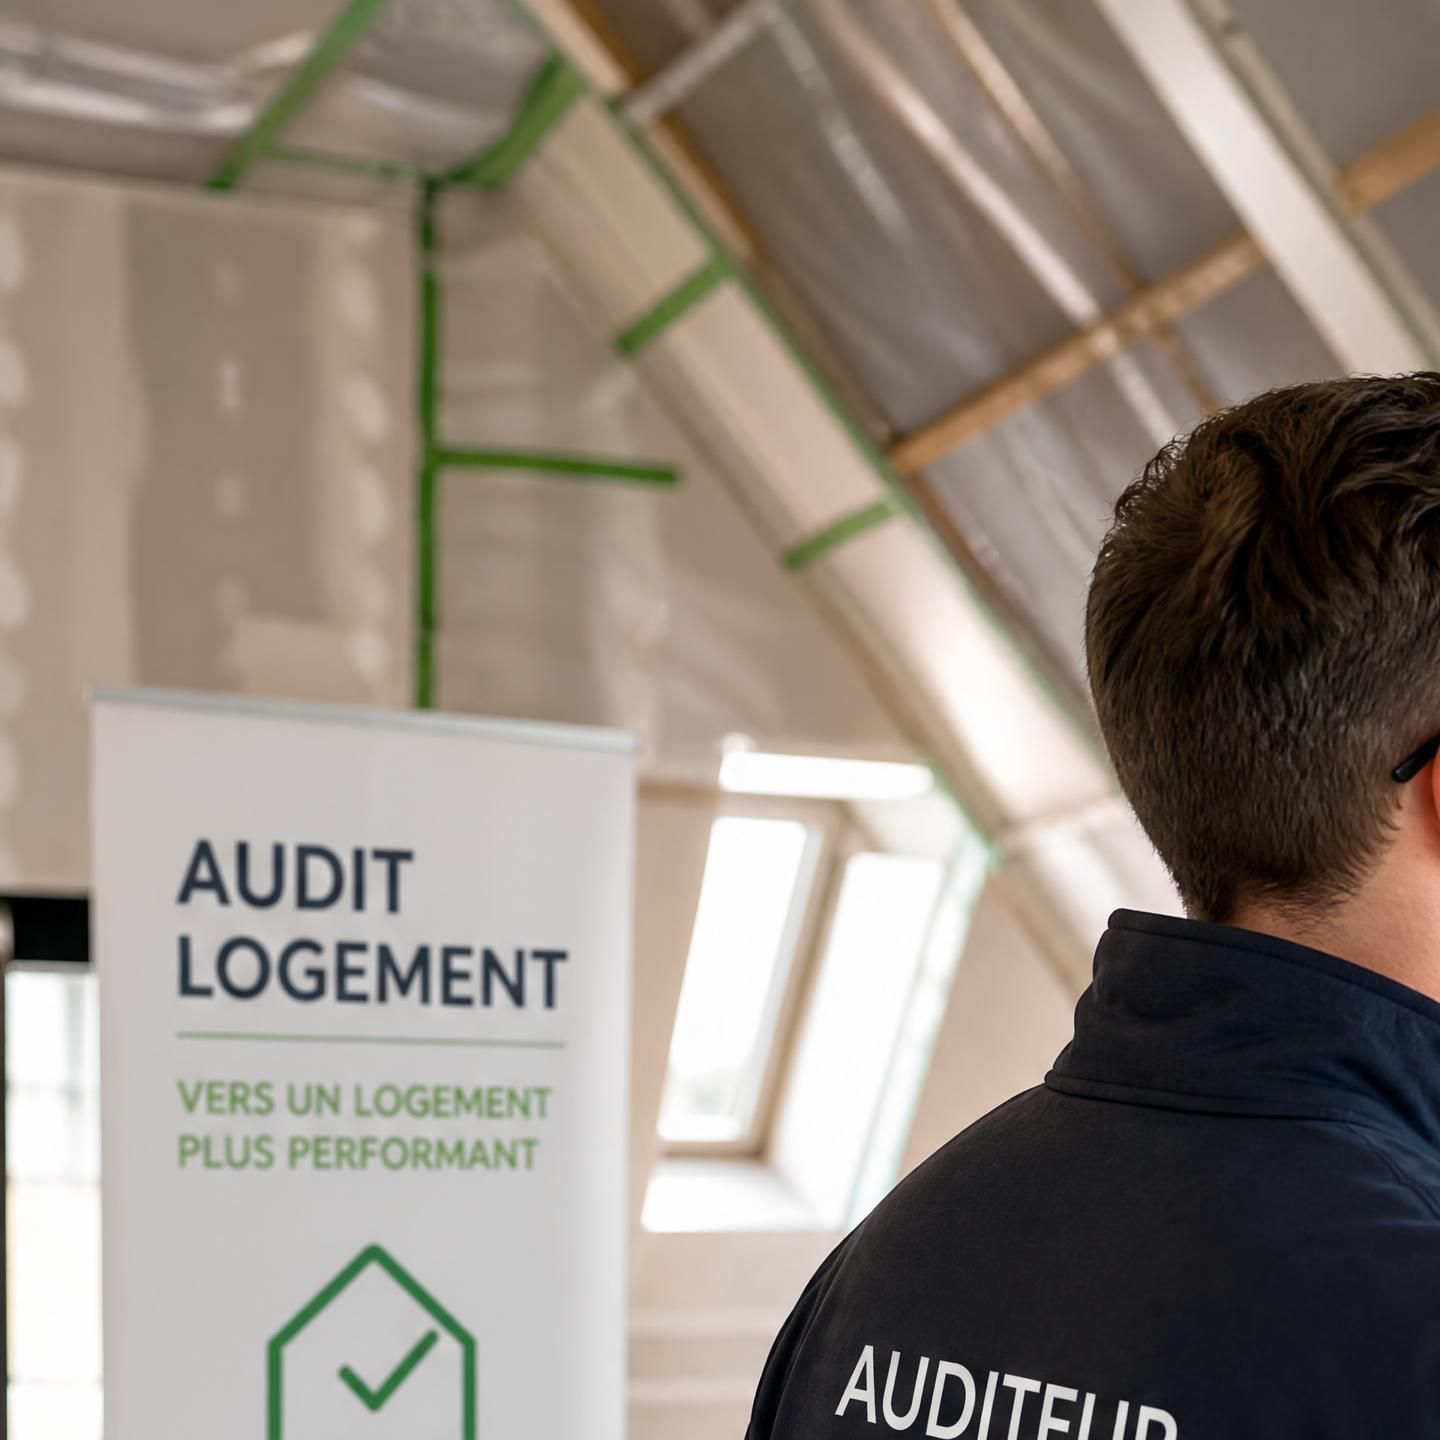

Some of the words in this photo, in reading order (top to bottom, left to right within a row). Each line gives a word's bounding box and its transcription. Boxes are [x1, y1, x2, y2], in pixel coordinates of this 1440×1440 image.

[176, 839, 414, 914] AUDIT
[178, 934, 569, 1010] LOGEMENT
[176, 1080, 275, 1117] VERS
[287, 1082, 342, 1118] UN
[354, 1083, 552, 1120] LOGEMENT
[177, 1133, 275, 1170] PLUS
[288, 1135, 539, 1171] PERFORMANT
